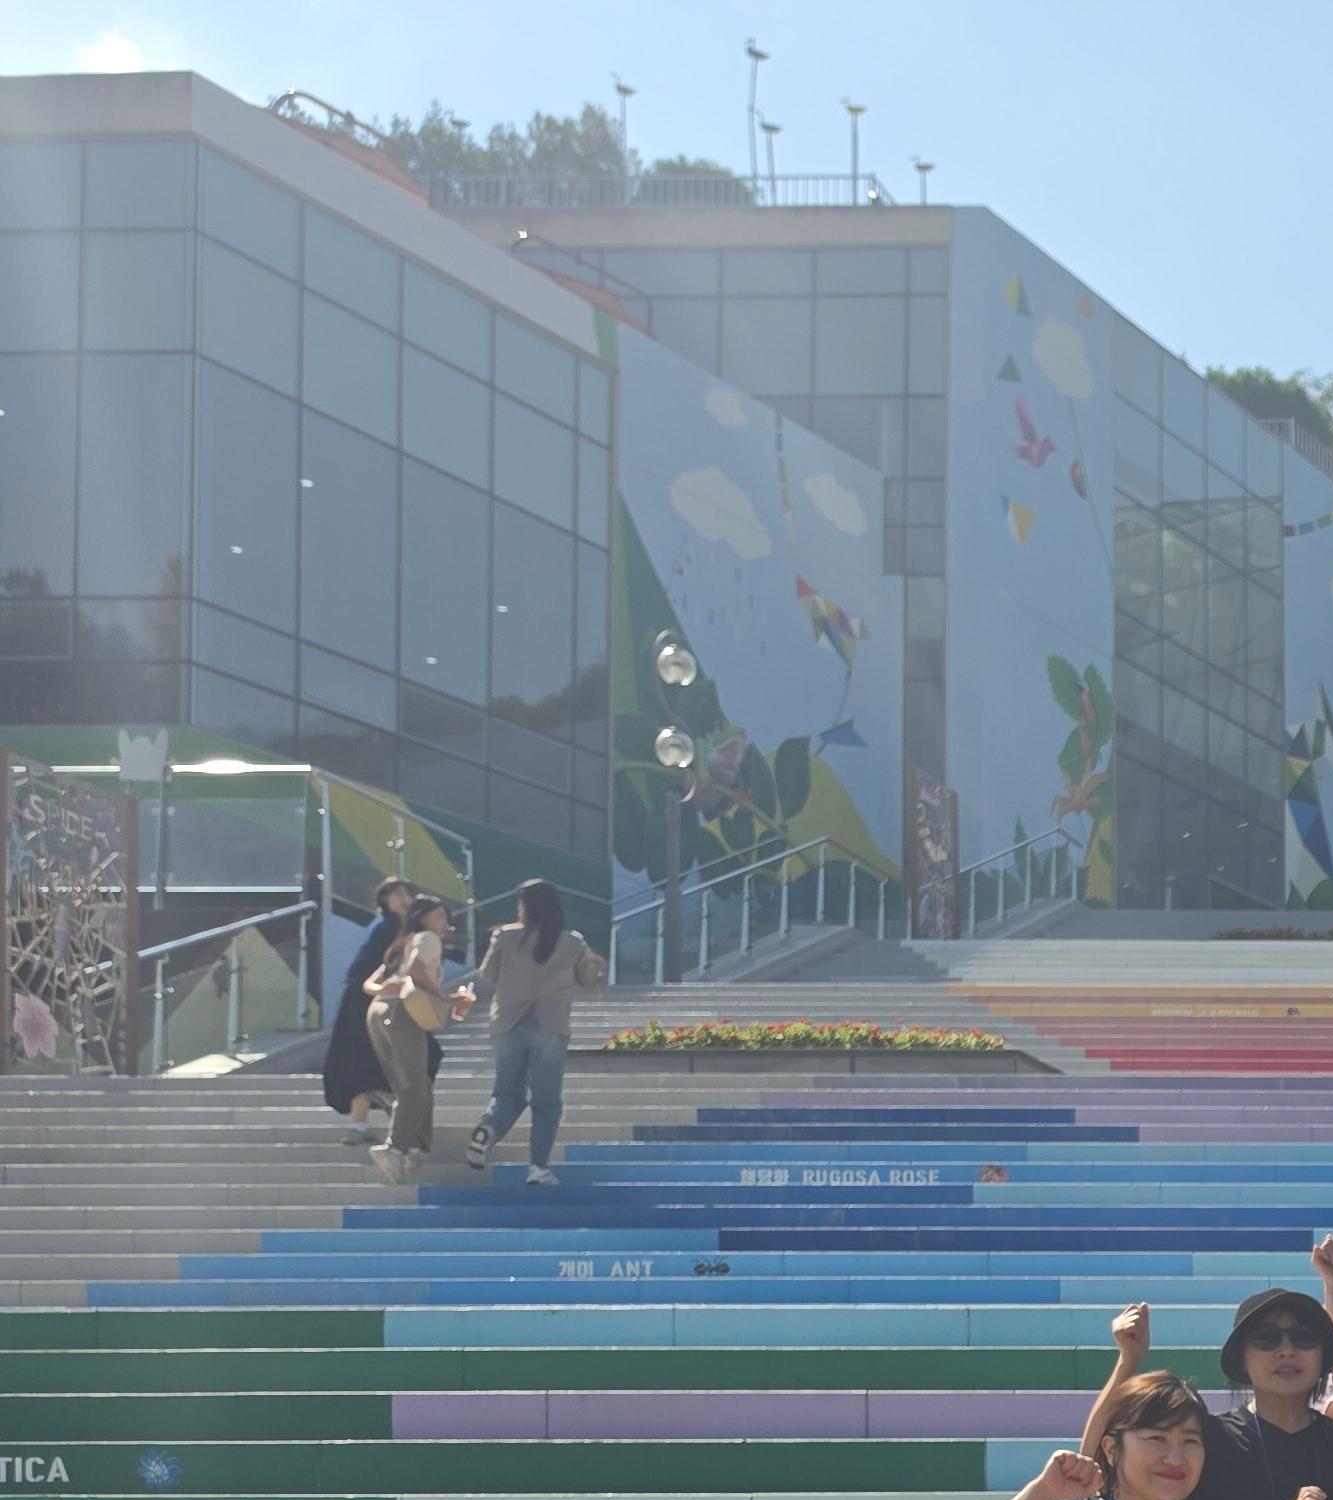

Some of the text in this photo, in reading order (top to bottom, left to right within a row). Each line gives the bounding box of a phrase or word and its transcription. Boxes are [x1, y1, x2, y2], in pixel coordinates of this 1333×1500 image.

[802, 1169, 881, 1186] RUGOSA
[889, 1169, 940, 1185] ROSE
[559, 1260, 655, 1277] 개미 ANT
